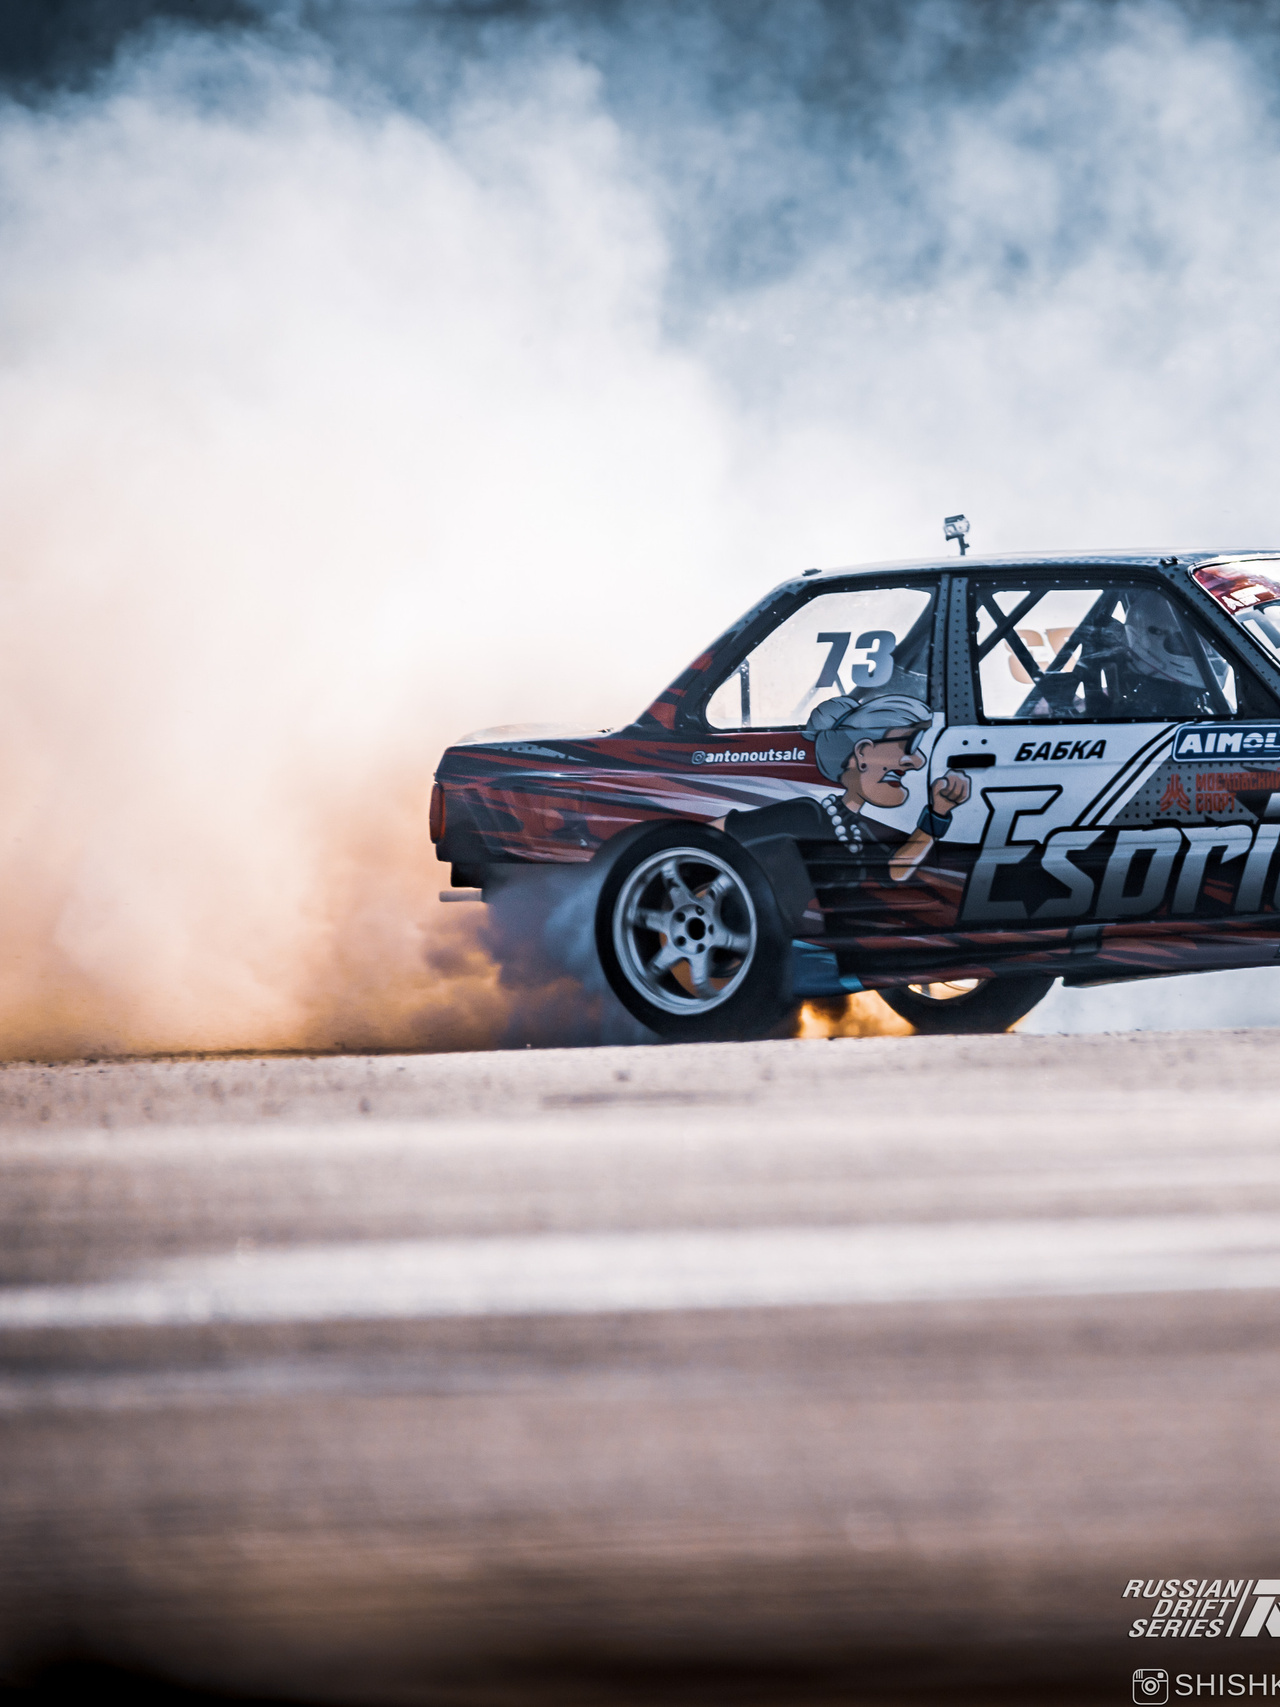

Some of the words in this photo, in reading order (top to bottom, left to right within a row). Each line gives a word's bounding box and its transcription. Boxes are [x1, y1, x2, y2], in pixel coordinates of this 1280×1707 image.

[815, 630, 897, 688] 73
[1014, 739, 1107, 762] БАБКА
[1195, 792, 1236, 812] СПОРТ
